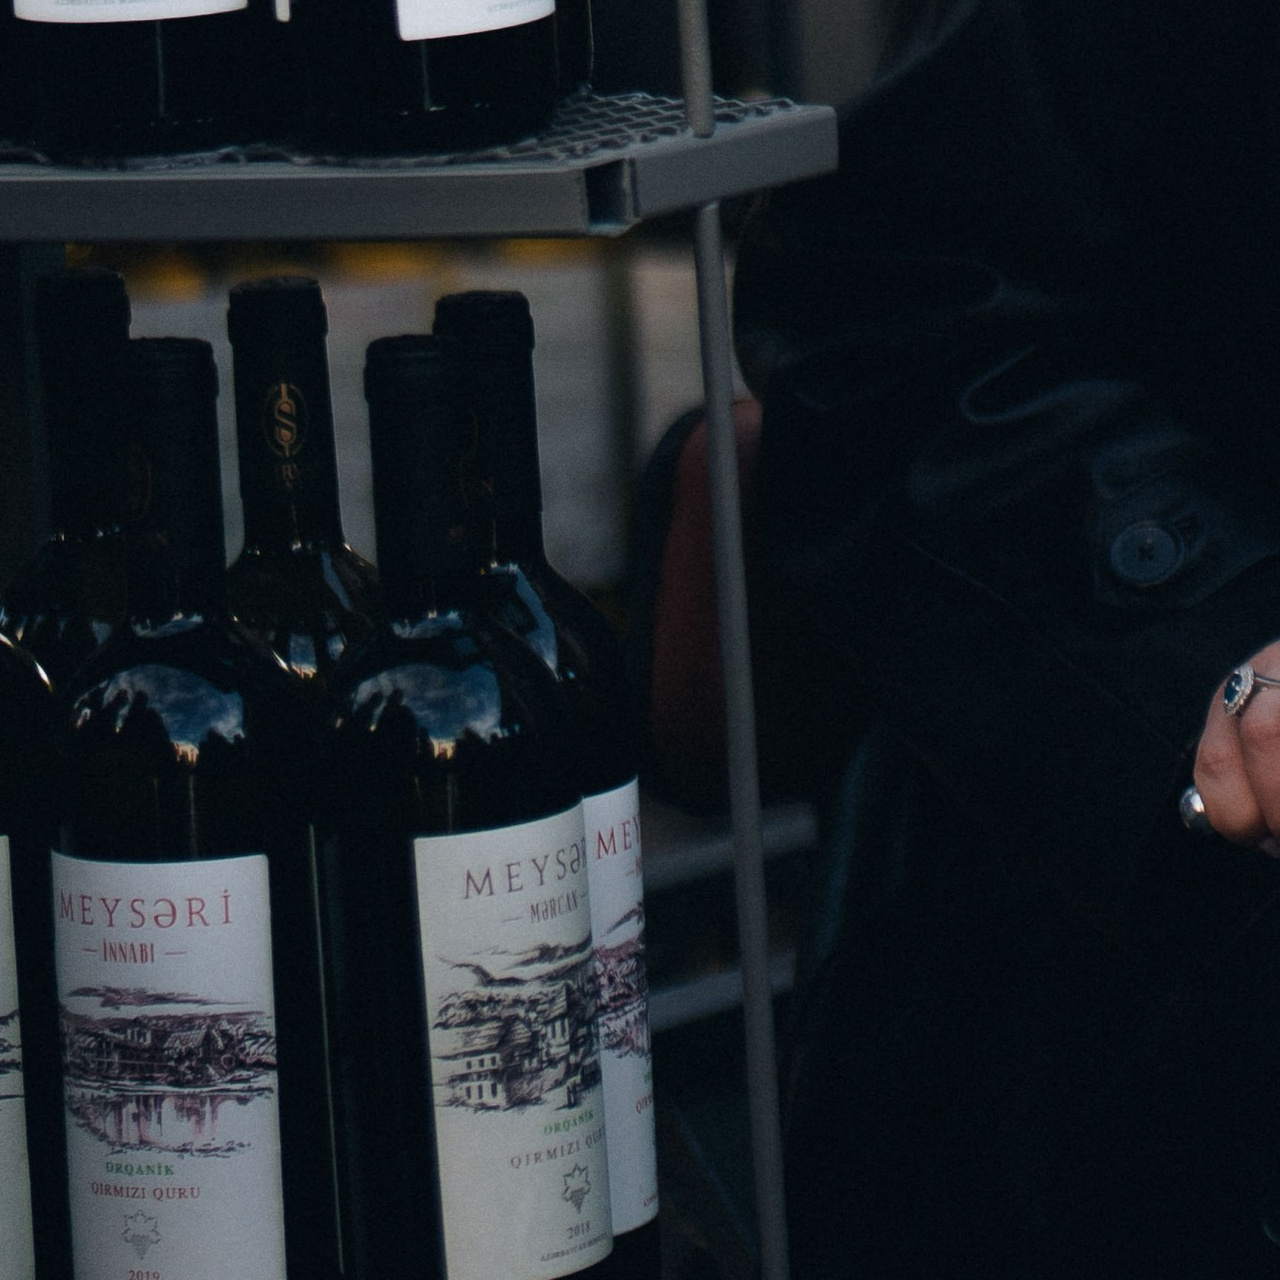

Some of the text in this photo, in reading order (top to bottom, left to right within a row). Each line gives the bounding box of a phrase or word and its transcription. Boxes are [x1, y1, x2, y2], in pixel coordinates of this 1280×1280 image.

[59, 888, 234, 930] MEYSƏRİ
[510, 1139, 581, 1170] QIRMIZI
[105, 1160, 175, 1177] ORQANİK
[90, 1180, 203, 1203] QIRMIZI QURU
[127, 1268, 161, 1280] 2019
